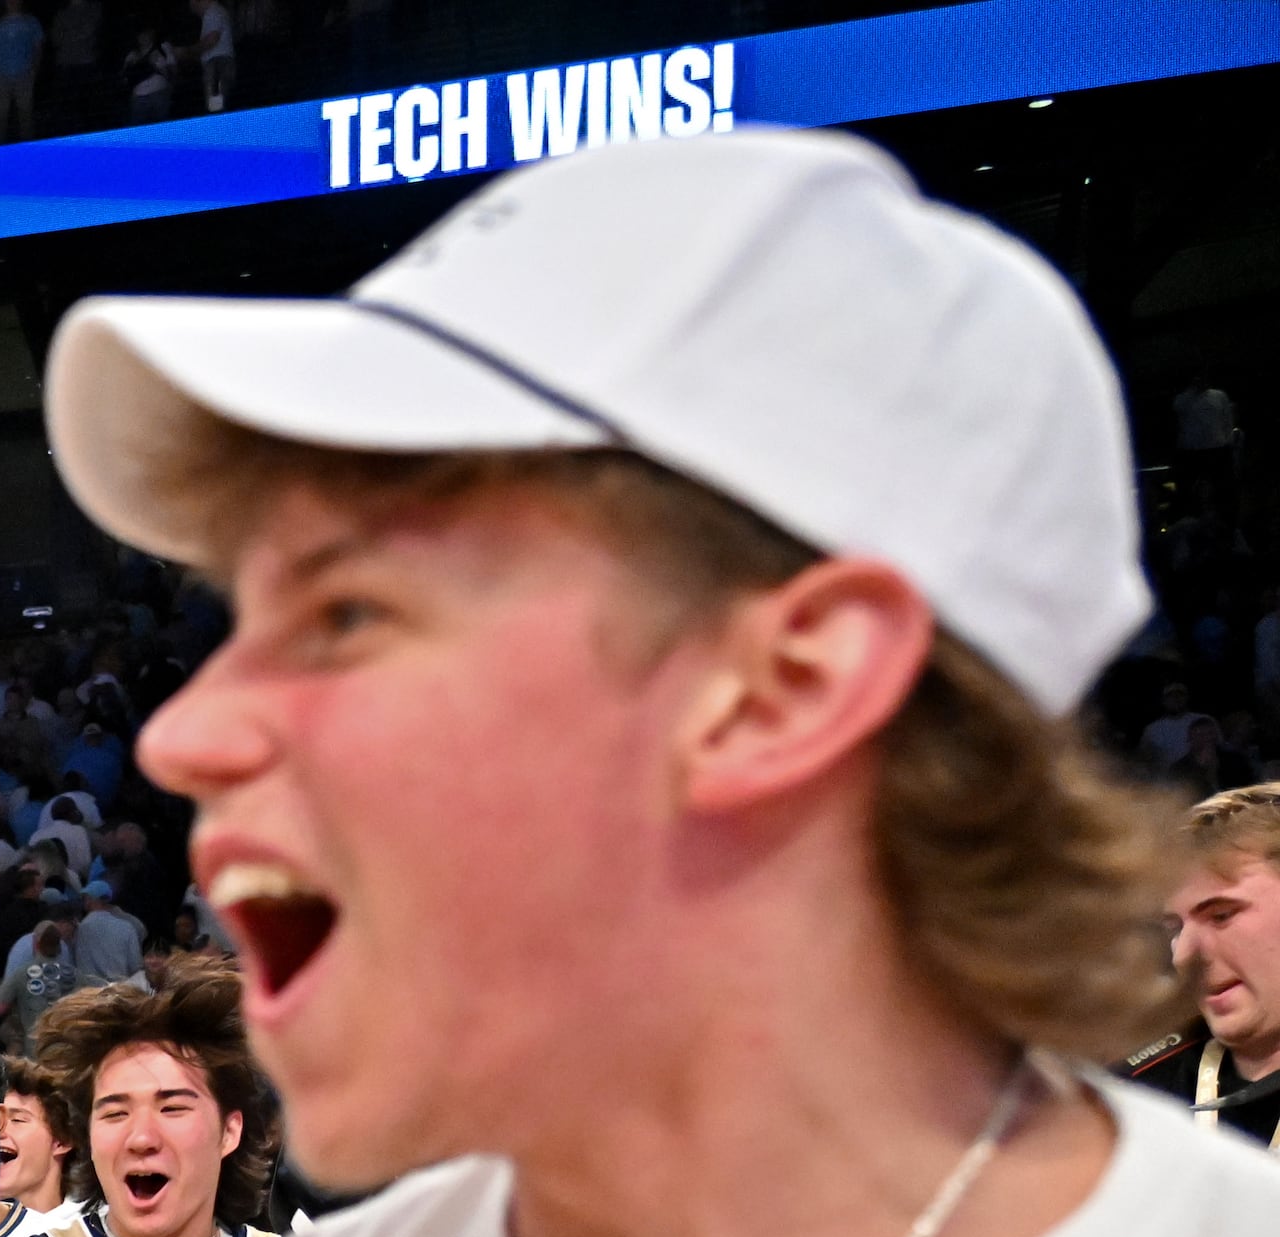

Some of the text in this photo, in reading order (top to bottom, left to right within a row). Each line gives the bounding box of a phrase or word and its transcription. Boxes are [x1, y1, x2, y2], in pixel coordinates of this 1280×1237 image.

[322, 43, 736, 189] TECH WINS!
[1127, 1034, 1181, 1066] Canon
